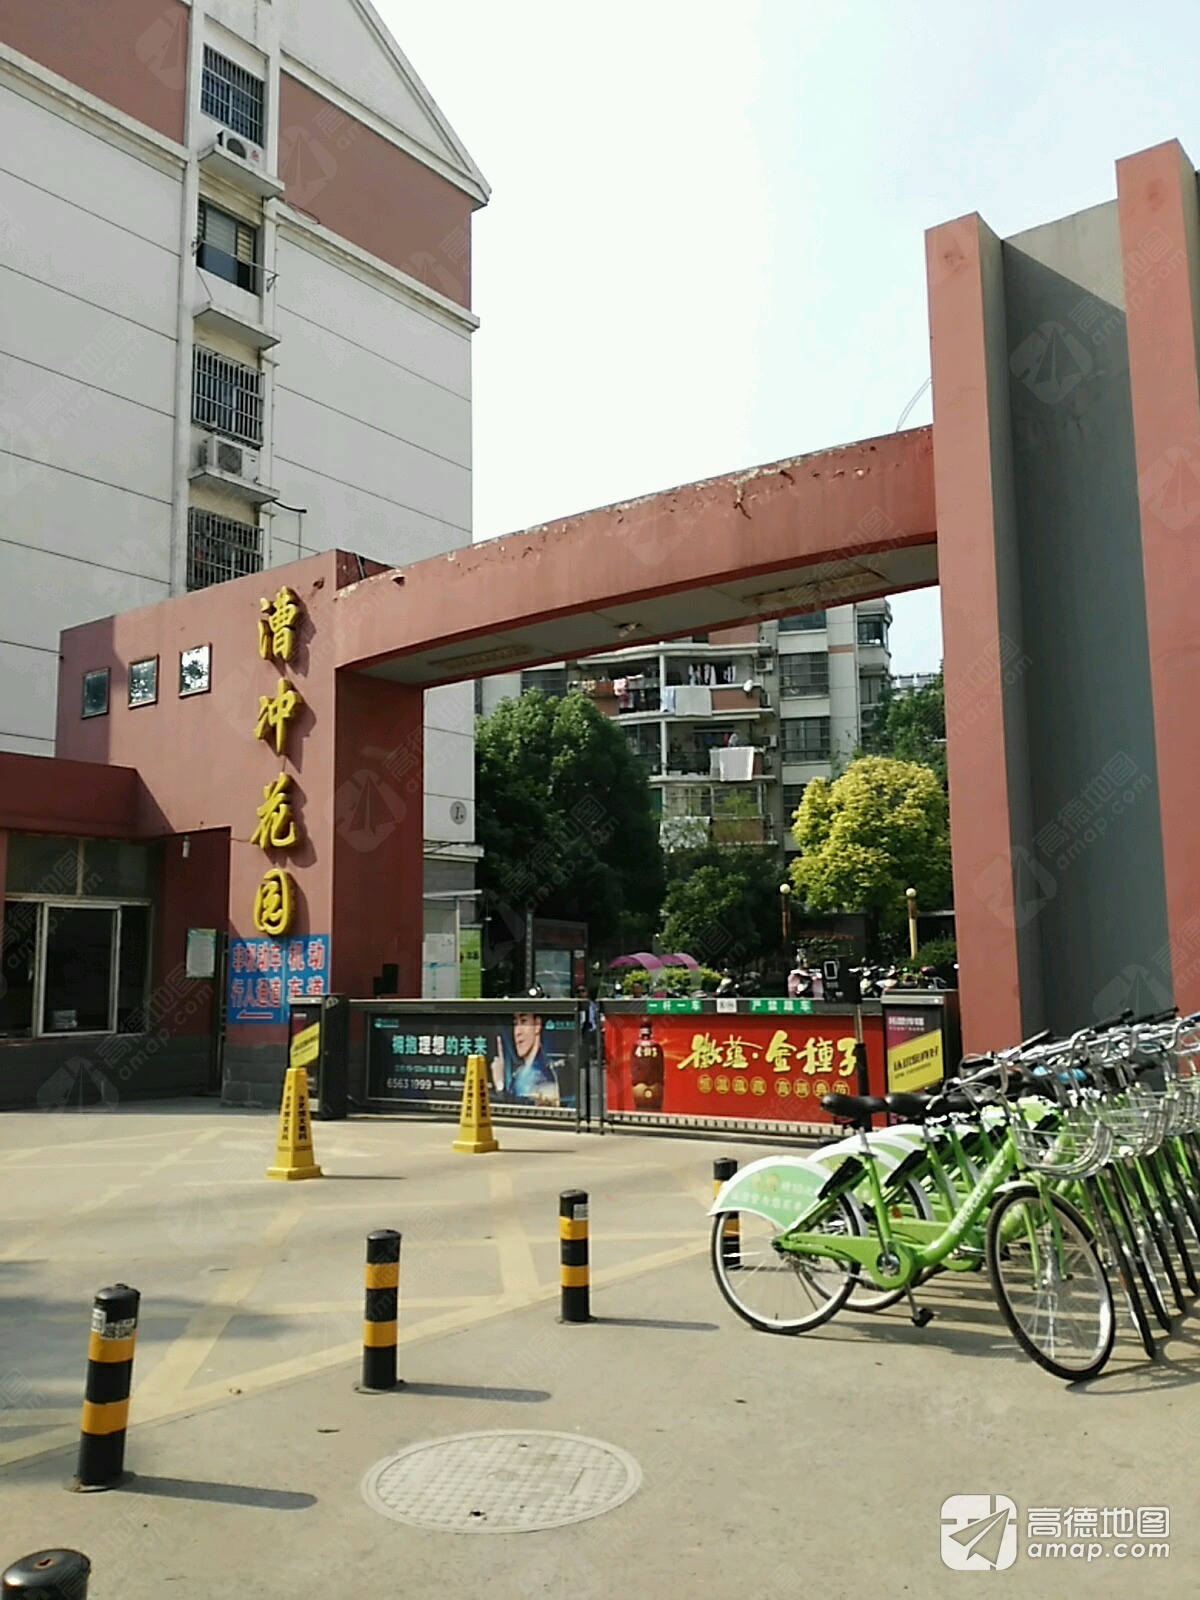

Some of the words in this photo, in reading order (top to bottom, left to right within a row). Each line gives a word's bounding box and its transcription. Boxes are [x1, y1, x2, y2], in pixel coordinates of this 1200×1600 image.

[251, 586, 298, 935] 漕冲花园
[233, 942, 281, 973] 非机动车
[231, 977, 281, 1008] 行人通道
[392, 1035, 488, 1056] 拥抱理想的未来
